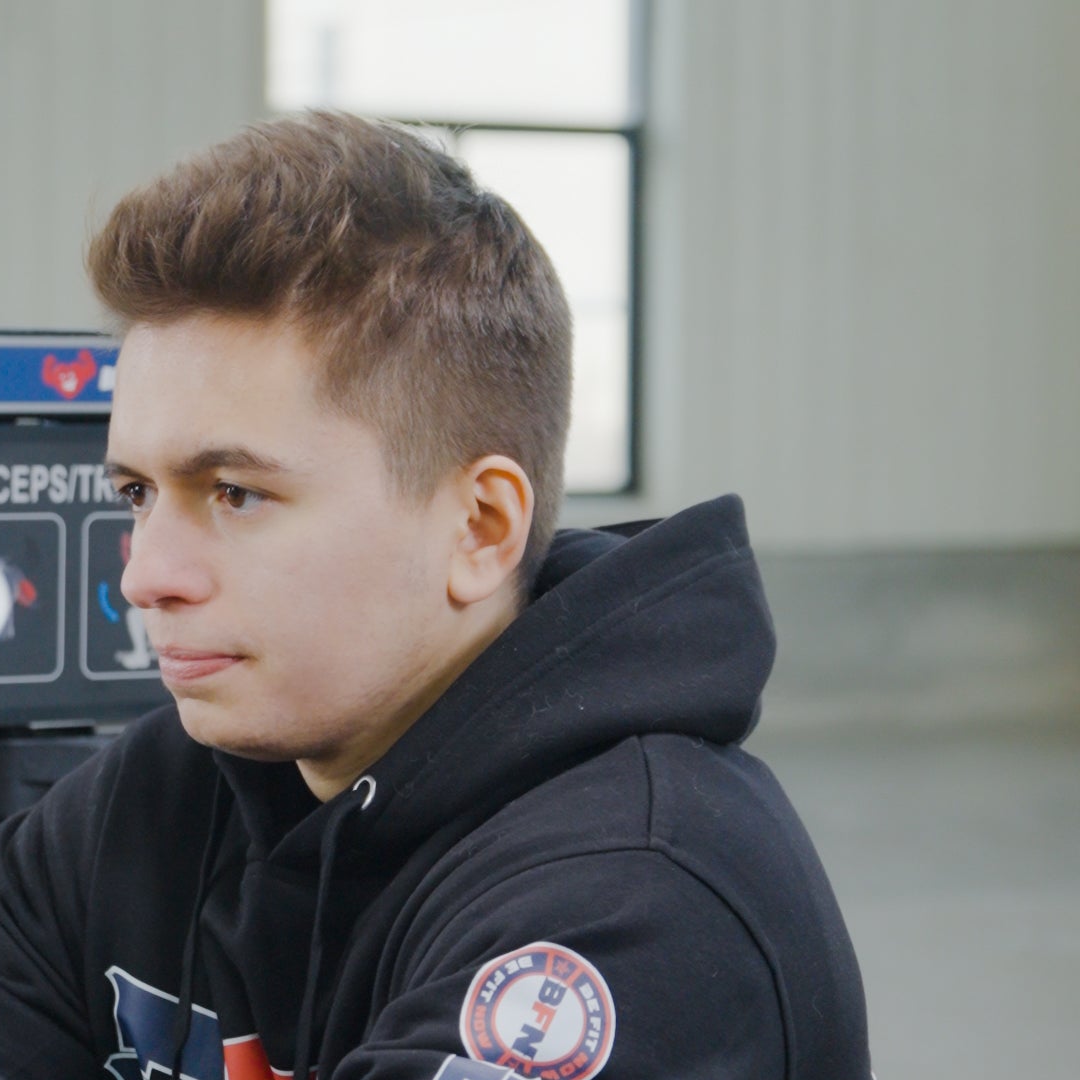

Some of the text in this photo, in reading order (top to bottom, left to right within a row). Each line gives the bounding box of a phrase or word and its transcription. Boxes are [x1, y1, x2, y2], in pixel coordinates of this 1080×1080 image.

[480, 969, 506, 1003] FIT
[511, 977, 568, 1061] BFN
[585, 1016, 602, 1053] FIT
